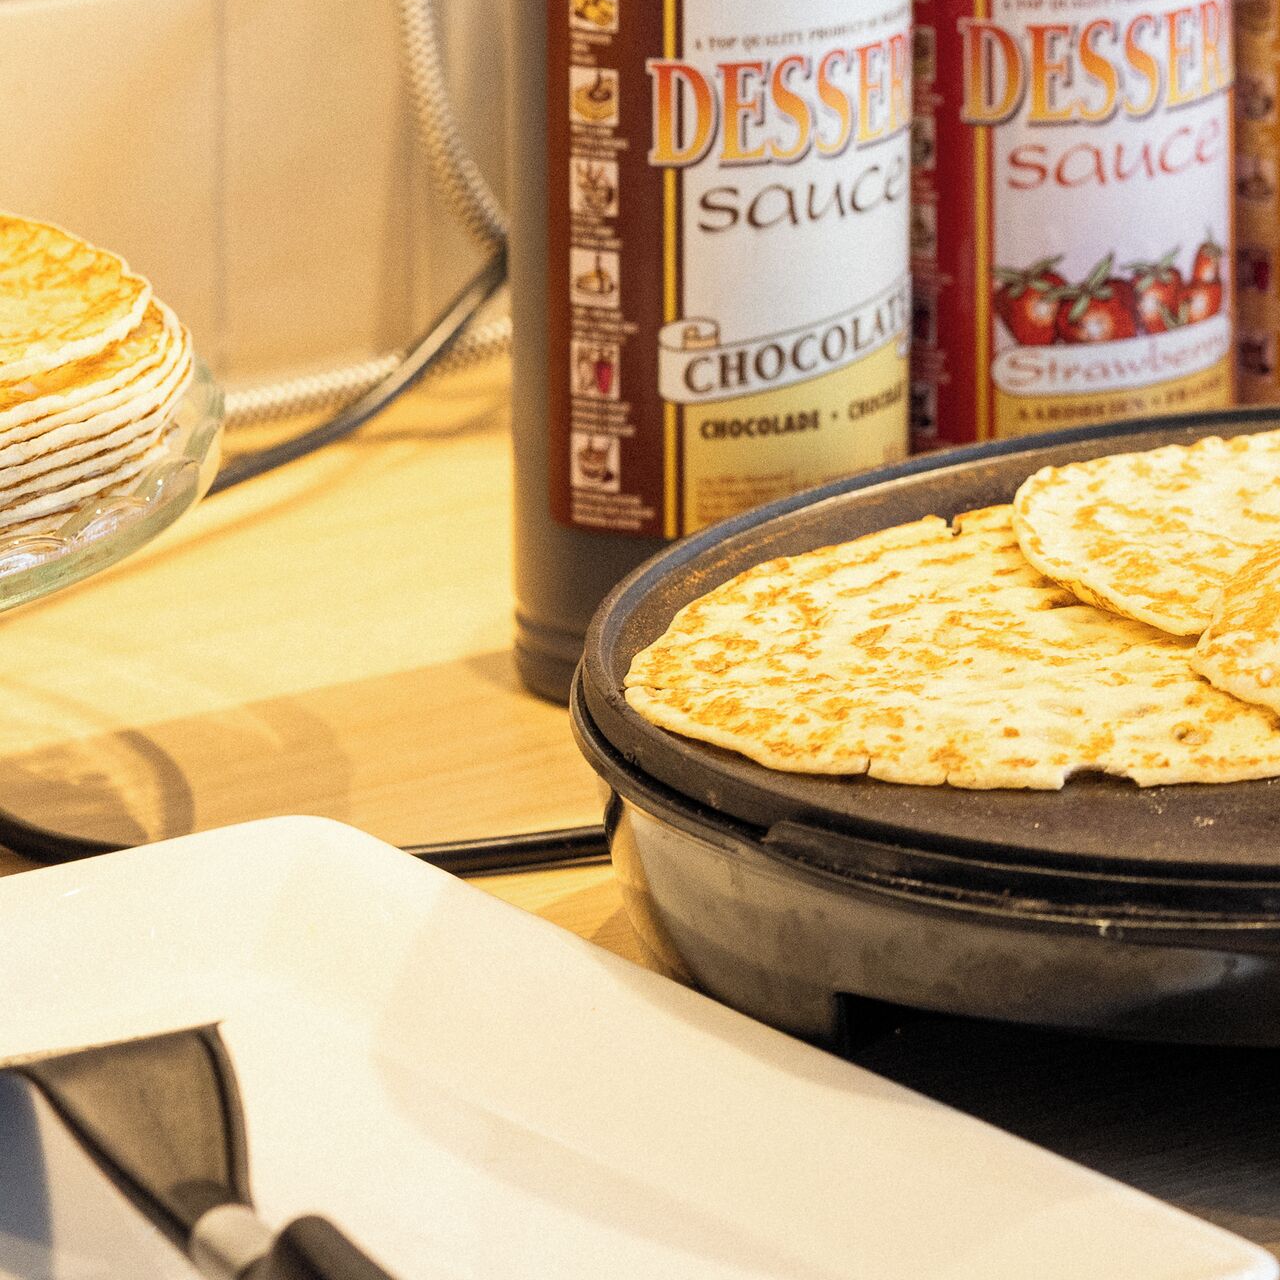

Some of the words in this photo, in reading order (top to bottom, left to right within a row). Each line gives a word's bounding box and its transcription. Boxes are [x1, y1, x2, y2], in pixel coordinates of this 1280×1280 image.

[649, 28, 909, 167] DESSER
[1007, 118, 1221, 191] sauce
[698, 156, 906, 234] sauce
[700, 409, 821, 441] CHOCOLADE
